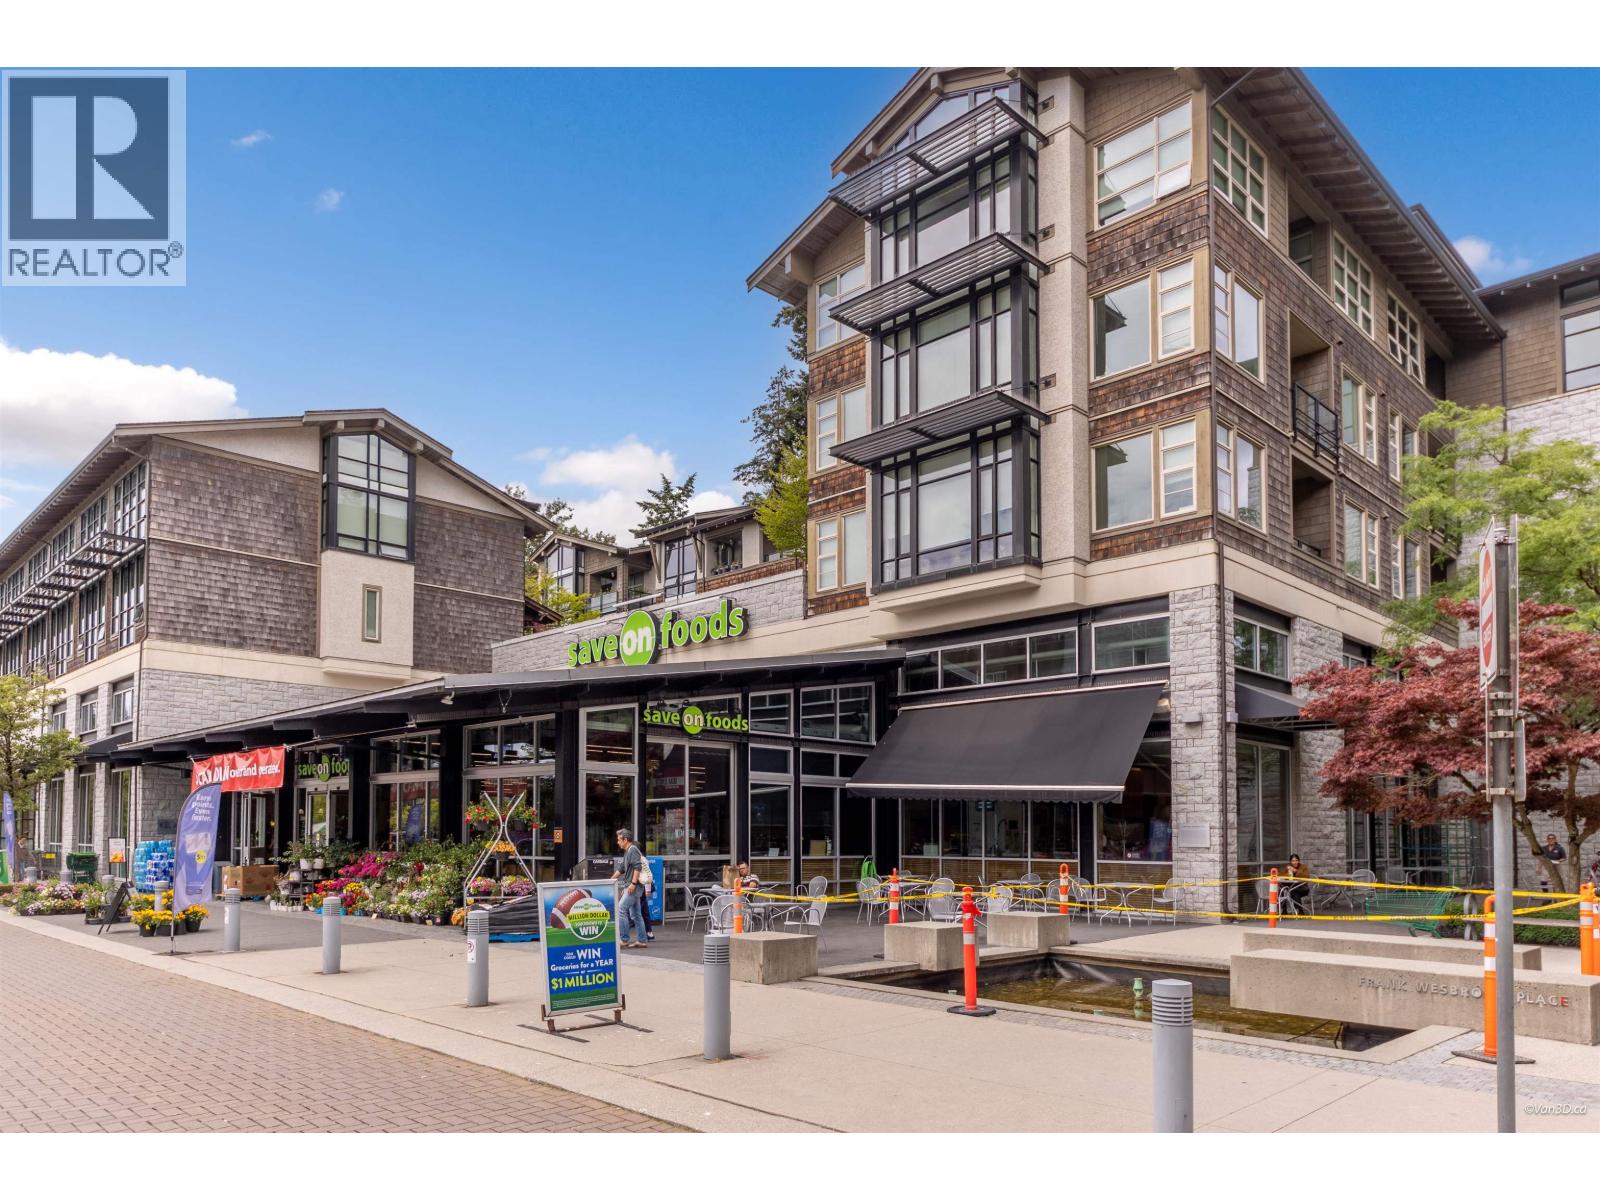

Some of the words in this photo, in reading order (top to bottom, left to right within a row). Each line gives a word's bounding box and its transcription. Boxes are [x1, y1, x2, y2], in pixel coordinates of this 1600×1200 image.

[567, 634, 618, 667] save
[622, 626, 653, 656] on
[660, 599, 744, 649] foods
[643, 708, 680, 725] save
[683, 710, 704, 727] on
[705, 713, 749, 731] foods
[298, 763, 316, 776] save
[317, 763, 329, 775] on
[568, 913, 588, 921] MILLION
[590, 911, 609, 919] DOLLAR
[579, 926, 599, 936] WIN
[576, 948, 602, 960] WIN
[550, 963, 579, 972] Groceries
[580, 961, 590, 969] for
[595, 958, 614, 967] YEAR
[551, 977, 563, 991] $1
[564, 971, 615, 988] MILLION
[1358, 977, 1408, 993] FRANK
[1415, 982, 1484, 999] WESBRO
[1516, 991, 1570, 1008] PLACE
